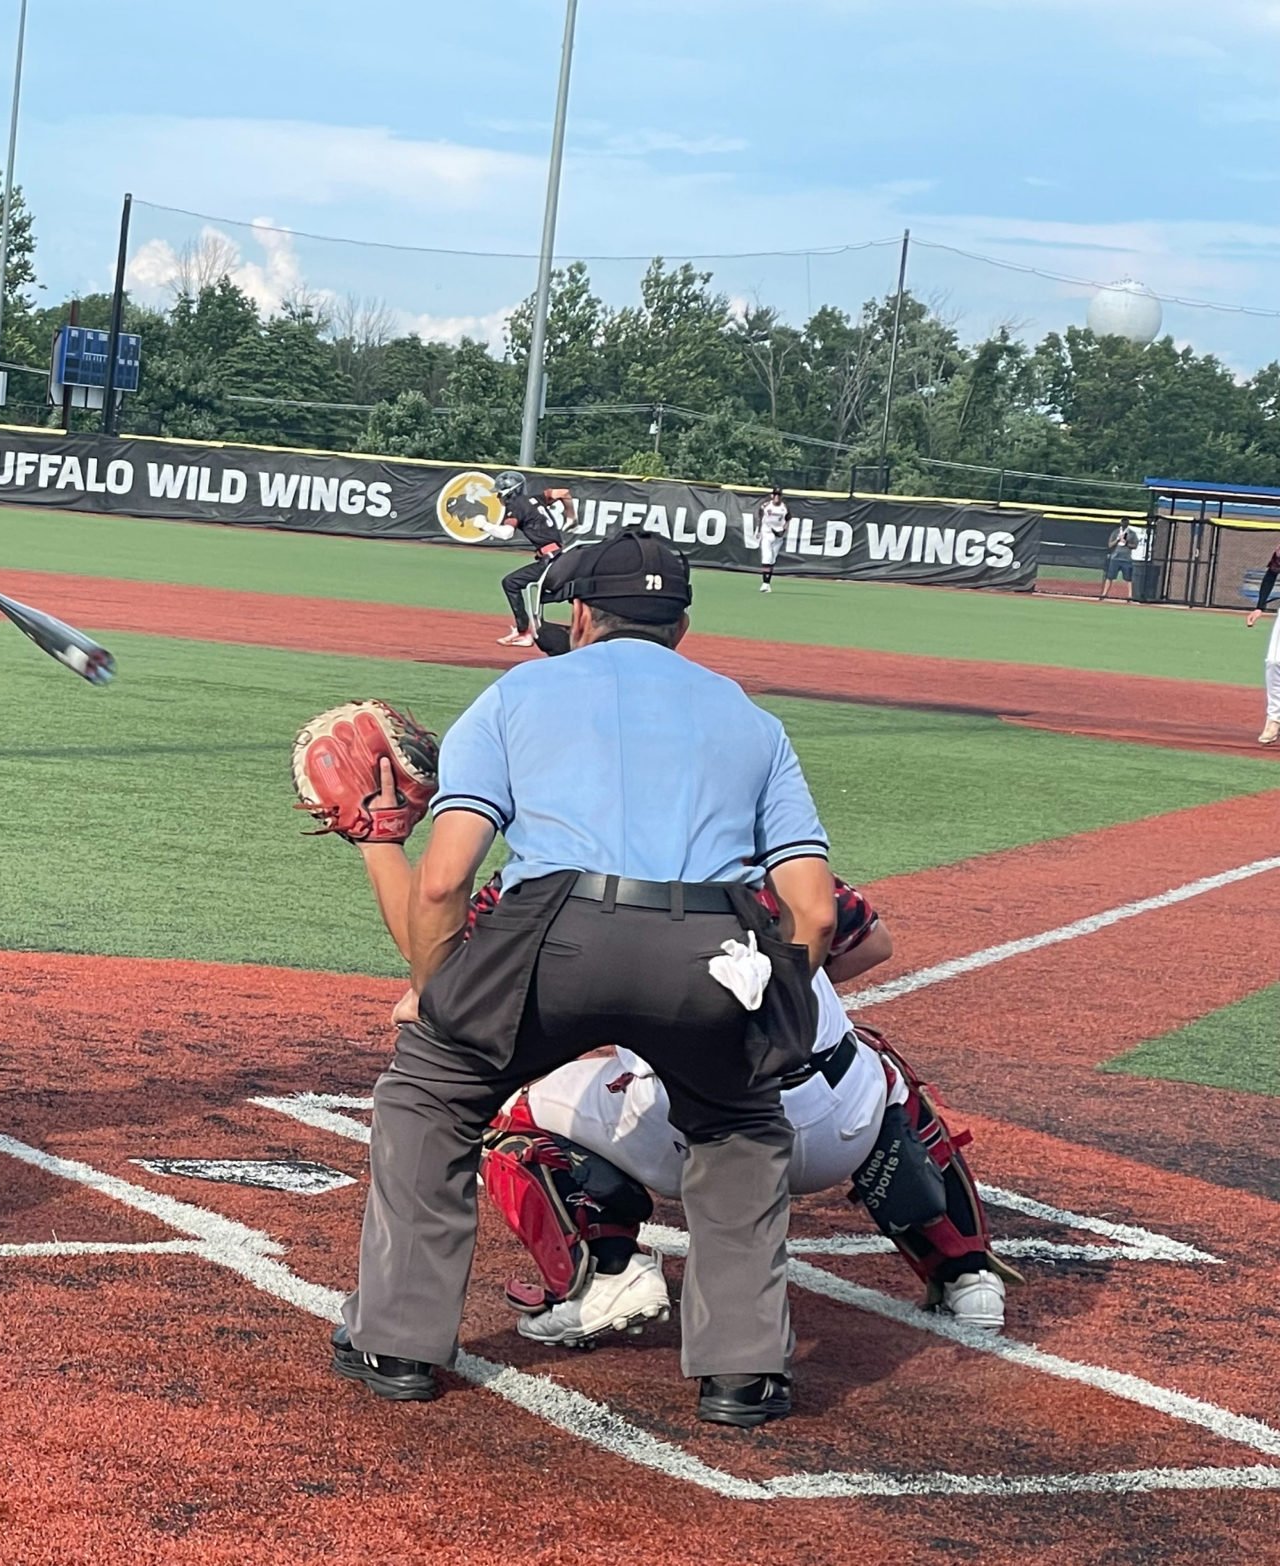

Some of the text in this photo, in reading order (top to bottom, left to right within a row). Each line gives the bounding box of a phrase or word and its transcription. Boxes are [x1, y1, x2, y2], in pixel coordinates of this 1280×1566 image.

[147, 462, 247, 505] WILD
[258, 472, 393, 518] WINGS
[866, 522, 1016, 569] WINGS
[645, 574, 663, 590] 79
[858, 1149, 886, 1188] Knee
